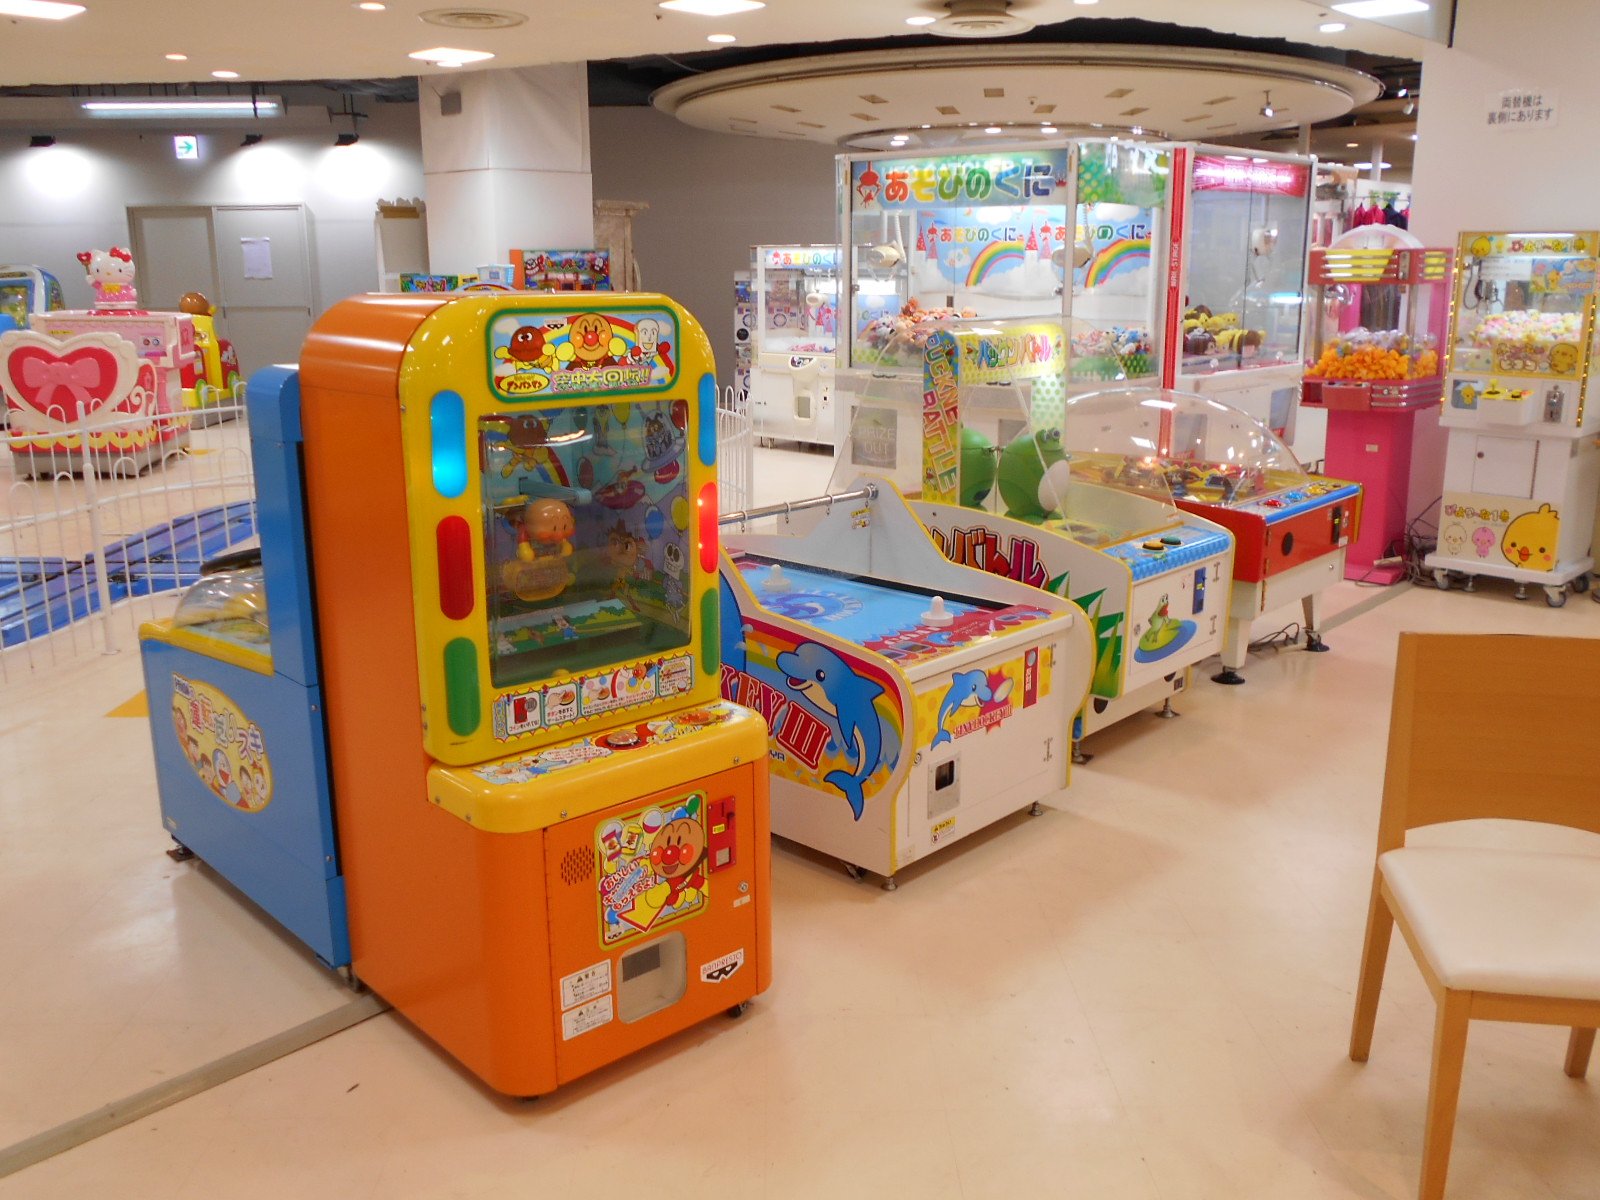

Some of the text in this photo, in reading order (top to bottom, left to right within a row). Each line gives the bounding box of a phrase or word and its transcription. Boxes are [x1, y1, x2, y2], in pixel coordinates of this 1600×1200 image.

[1488, 108, 1553, 124] 裏側にあります
[885, 163, 1053, 203] あそびのくに
[941, 227, 1017, 243] あそびのくに
[923, 390, 958, 494] BATTLE
[702, 952, 742, 974] BANPRESTO
